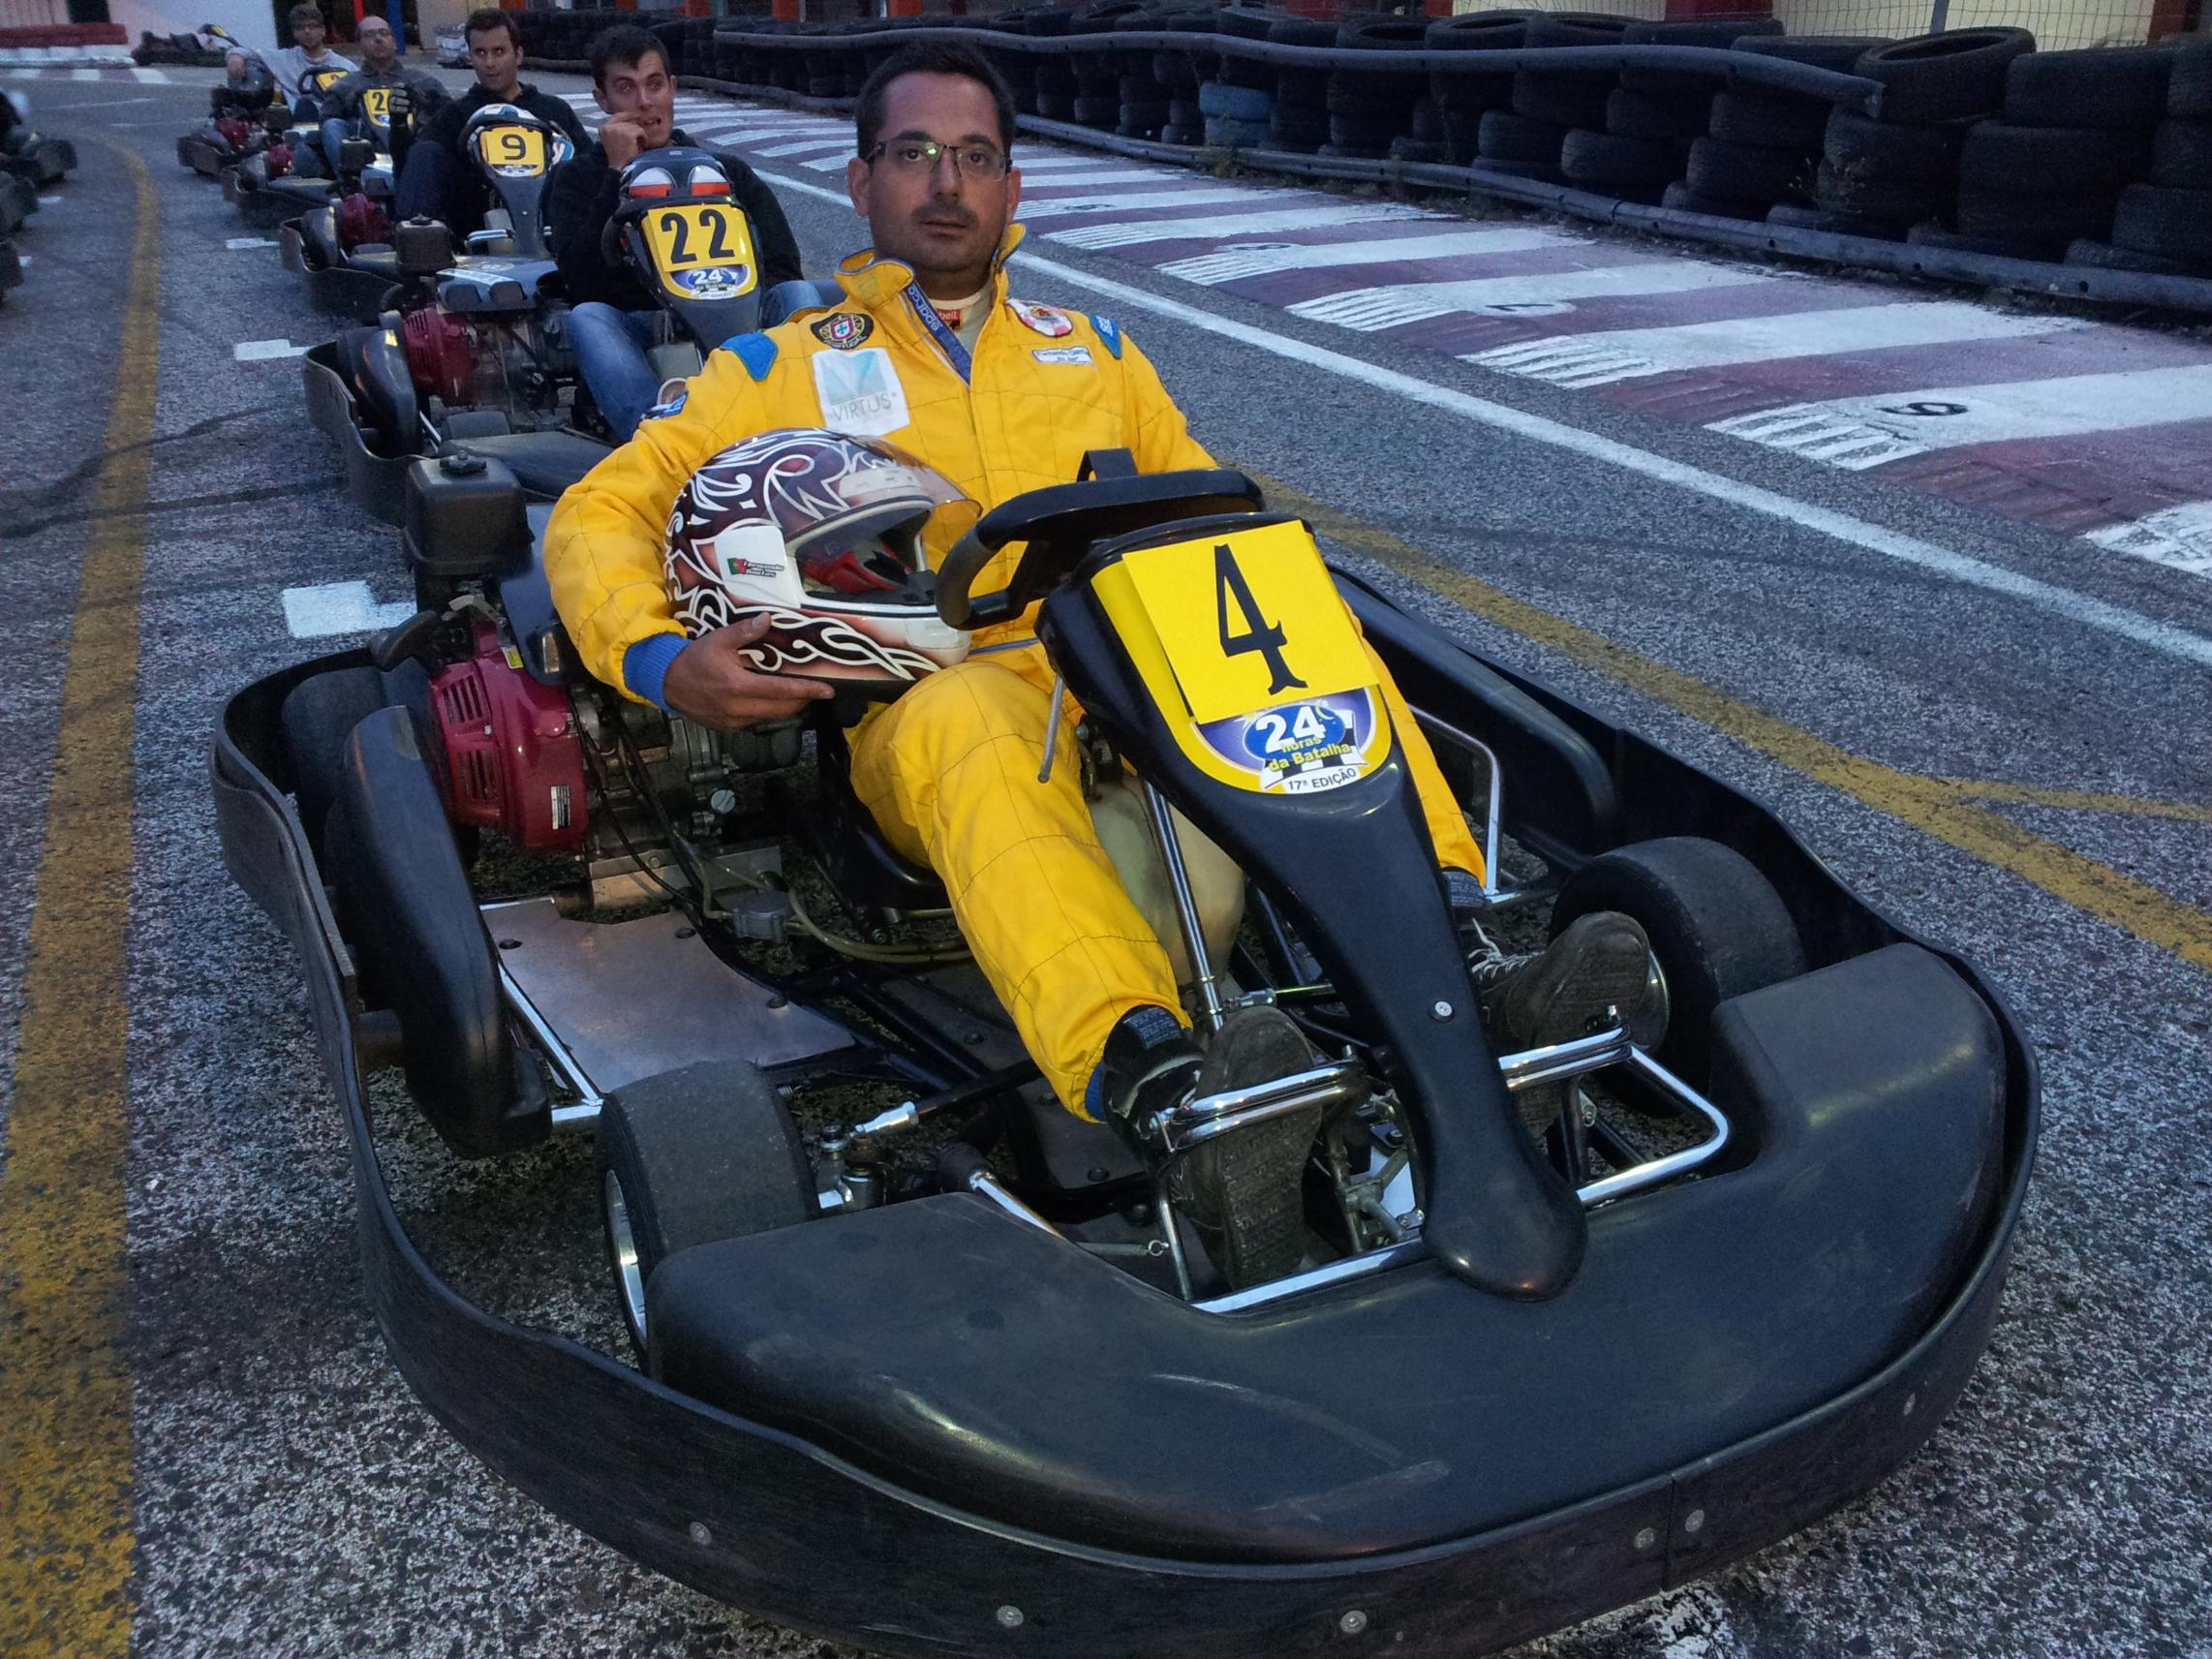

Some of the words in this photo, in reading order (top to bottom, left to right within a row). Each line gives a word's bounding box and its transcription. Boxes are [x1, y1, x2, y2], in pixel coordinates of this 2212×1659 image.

[501, 133, 527, 161] 9
[661, 208, 736, 264] 22
[693, 269, 723, 285] 24
[831, 392, 892, 422] VIRTUS
[1214, 543, 1308, 695] 4
[1255, 705, 1327, 753] 24
[1268, 757, 1290, 773] da
[1292, 742, 1351, 765] Batalha
[1310, 767, 1357, 788] EDIÇÃO
